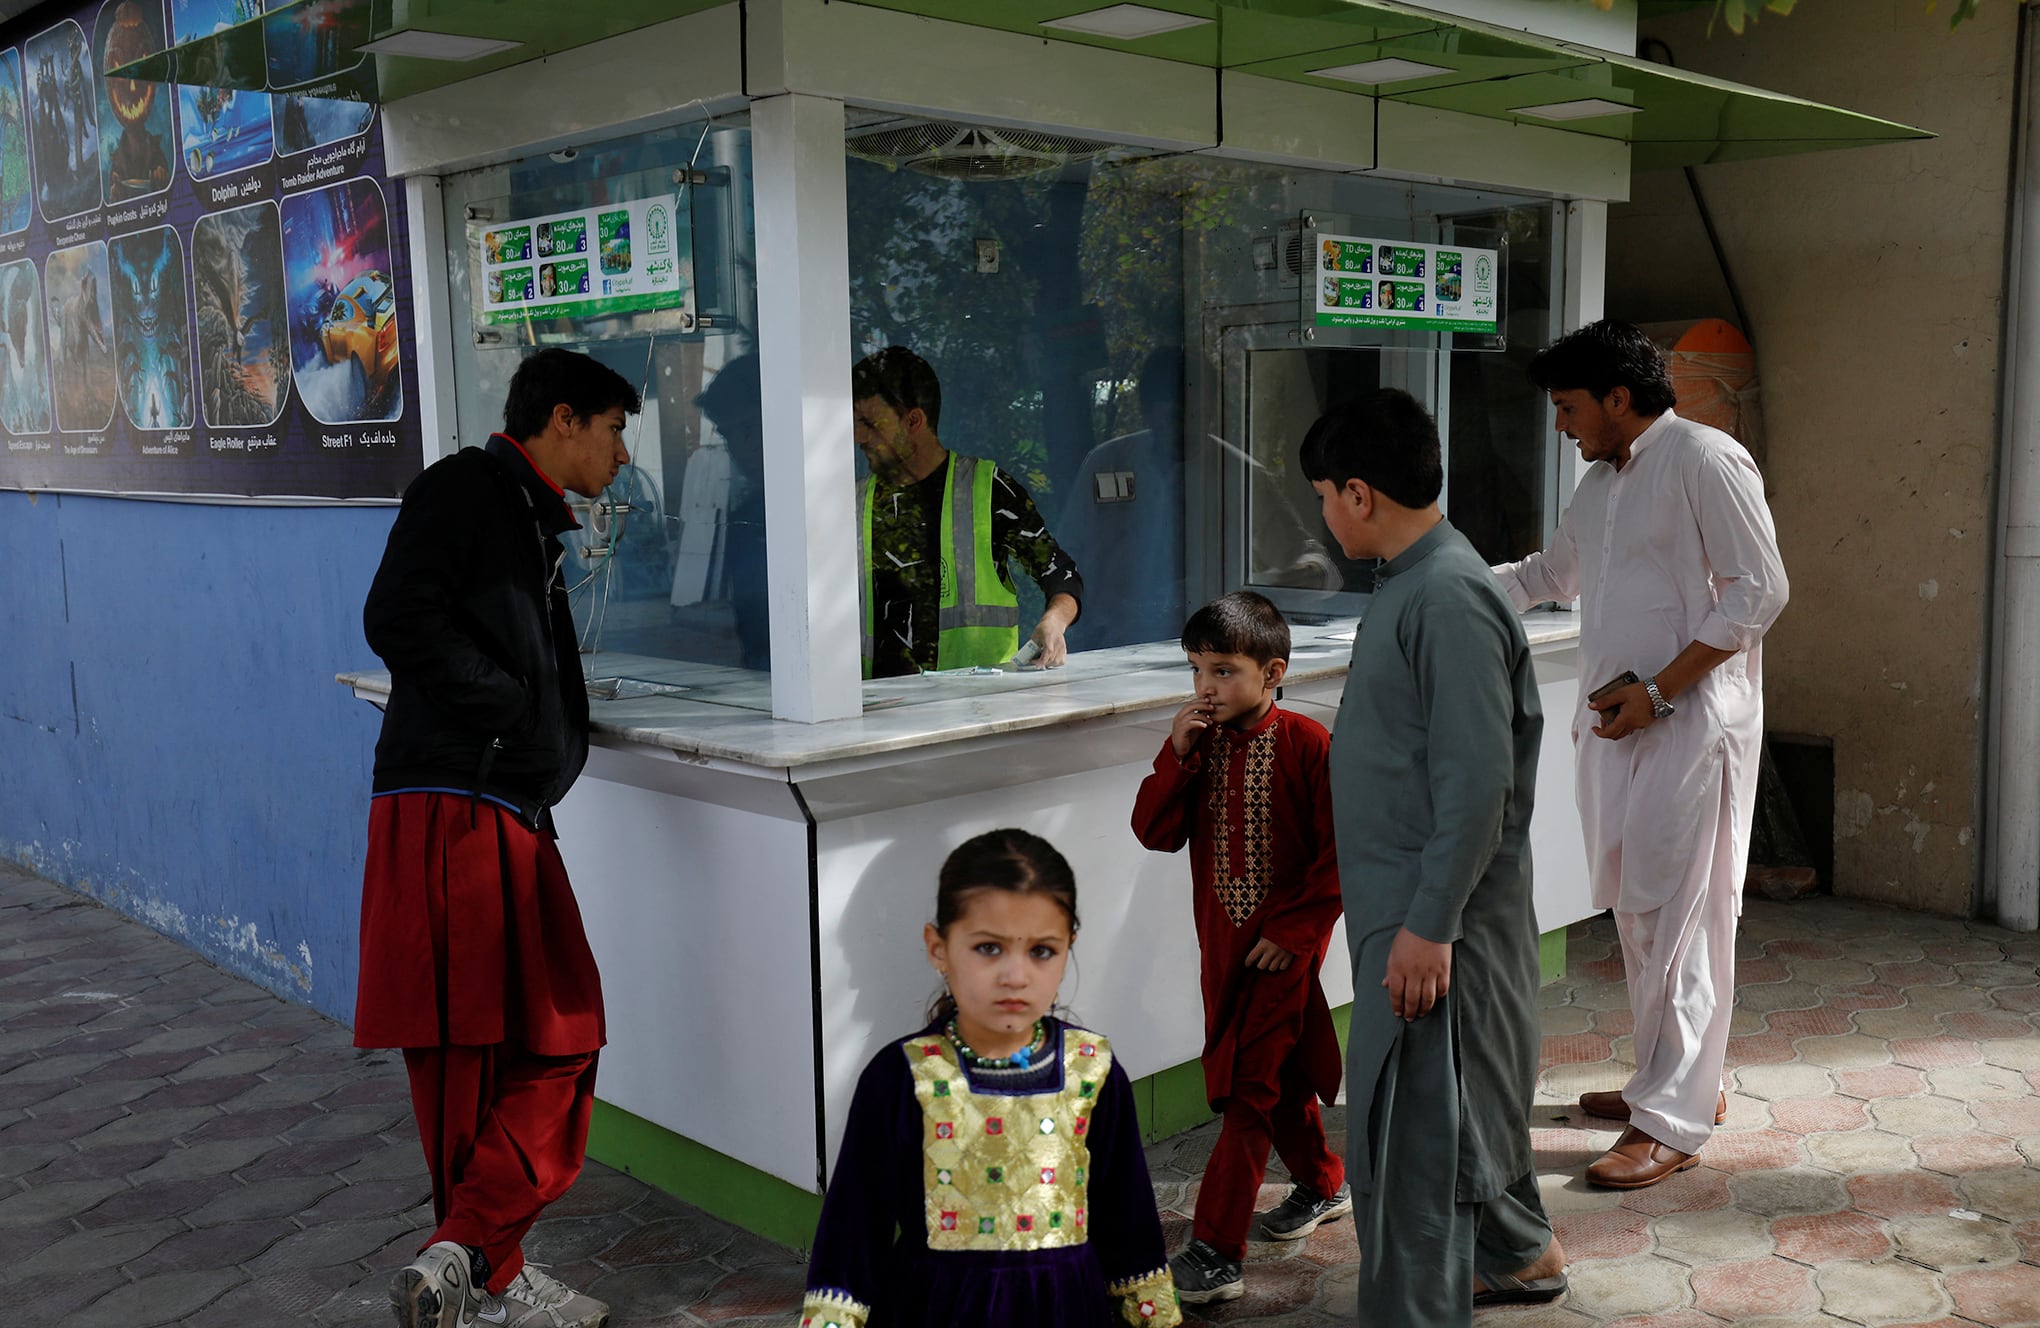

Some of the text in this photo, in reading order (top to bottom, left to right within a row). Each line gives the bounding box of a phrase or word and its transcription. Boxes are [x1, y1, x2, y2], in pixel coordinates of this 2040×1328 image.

[281, 164, 345, 190] Tomb Raider Adventure
[240, 176, 262, 197] دولفین
[212, 183, 238, 203] Dolphin
[600, 227, 609, 238] 30
[556, 240, 567, 253] 80
[580, 240, 587, 250] 3
[1346, 244, 1354, 253] 7D
[506, 248, 515, 260] 80
[526, 247, 531, 259] 1
[1345, 260, 1353, 270] 80
[1366, 263, 1371, 272] 1
[1397, 263, 1405, 275] 80
[1436, 261, 1444, 271] 30
[1419, 267, 1424, 277] 3
[558, 280, 569, 293] 30
[582, 280, 589, 292] 4
[528, 288, 533, 299] 2
[1345, 297, 1353, 307] 50
[1366, 298, 1371, 308] 2
[1396, 297, 1405, 310] 30
[1419, 301, 1424, 311] 4
[210, 437, 244, 451] Eagle Roller
[322, 434, 353, 448] Street F1
[359, 430, 396, 447] جاده اف یک
